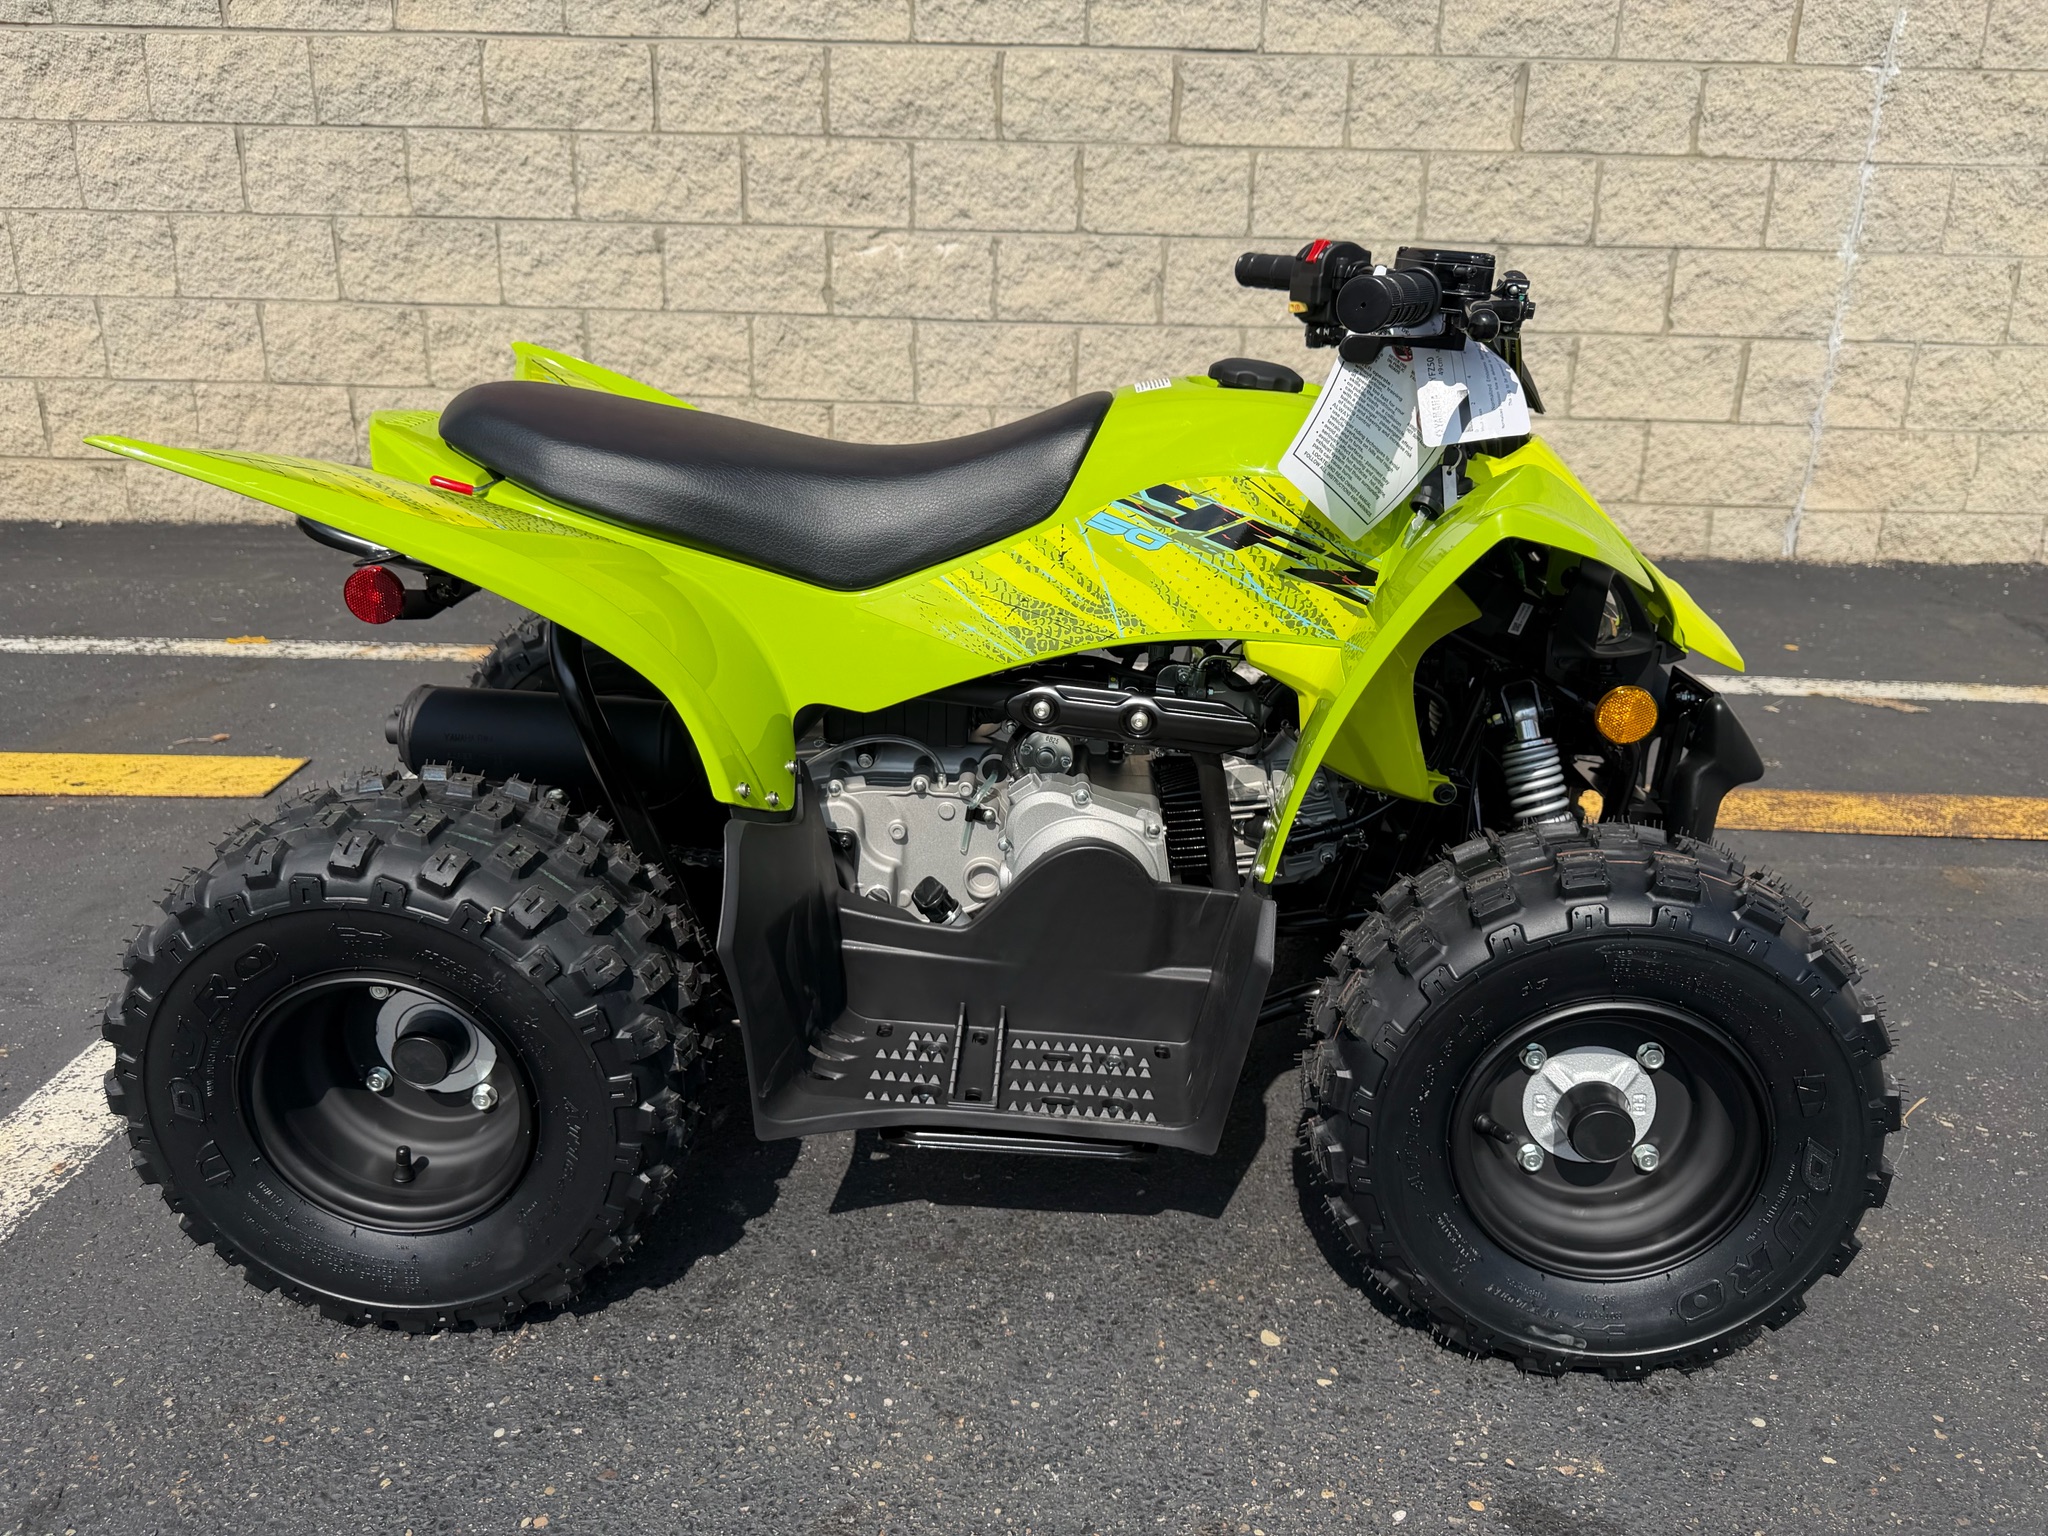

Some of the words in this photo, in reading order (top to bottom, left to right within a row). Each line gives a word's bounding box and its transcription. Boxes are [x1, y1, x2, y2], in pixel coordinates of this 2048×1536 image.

[1331, 401, 1353, 421] ALWAYS
[1303, 450, 1320, 468] FOLLOW
[1318, 464, 1327, 474] ALL
[1325, 470, 1352, 496] INSTRUCTIONS
[1349, 493, 1358, 503] AND
[1311, 449, 1328, 466] LOCATE
[1326, 462, 1336, 473] AND
[1334, 470, 1345, 482] READ
[1343, 479, 1360, 496] OWNER'S
[1085, 511, 1172, 551] 50
[1677, 1136, 1839, 1322] DURO
